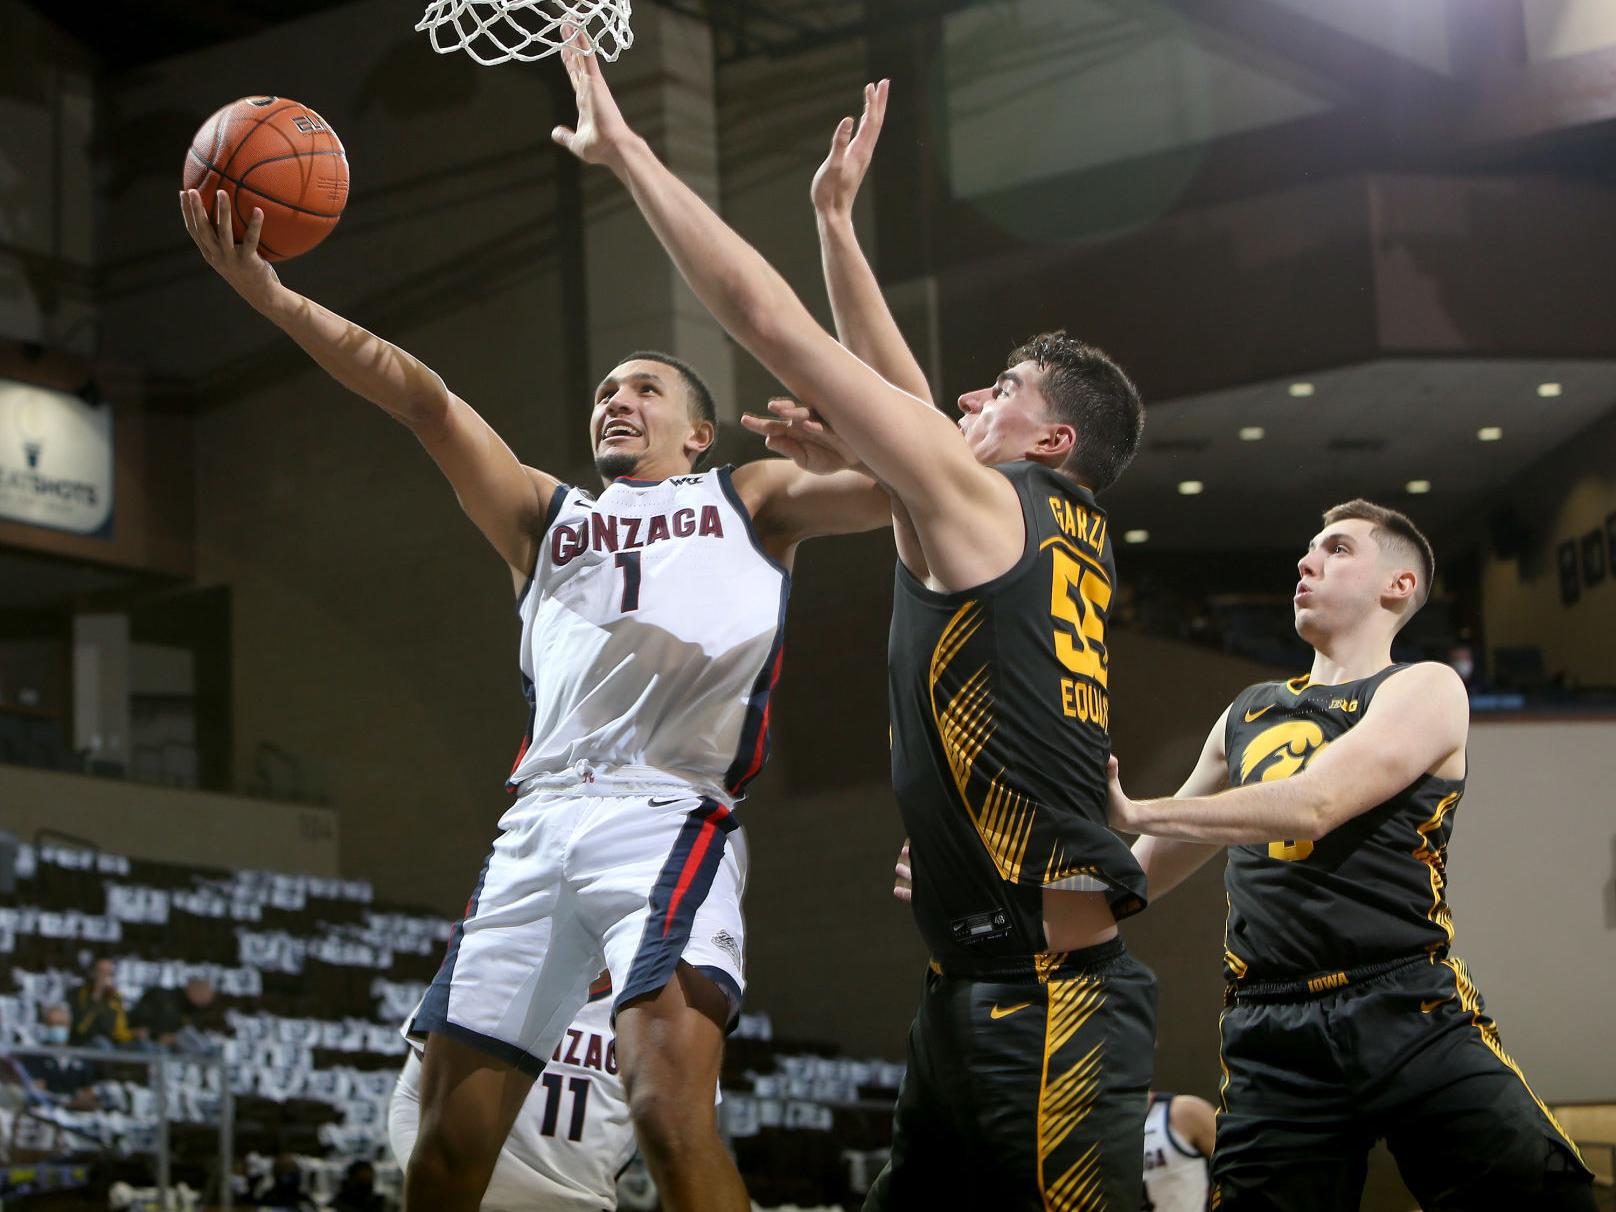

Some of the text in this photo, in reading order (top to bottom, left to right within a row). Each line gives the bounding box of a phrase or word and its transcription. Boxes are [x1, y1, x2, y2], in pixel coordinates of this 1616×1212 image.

[1049, 496, 1108, 558] GARZA
[615, 551, 642, 614] 1
[1051, 547, 1112, 690] 55
[1307, 971, 1349, 993] IOWA
[540, 1072, 592, 1142] 11
